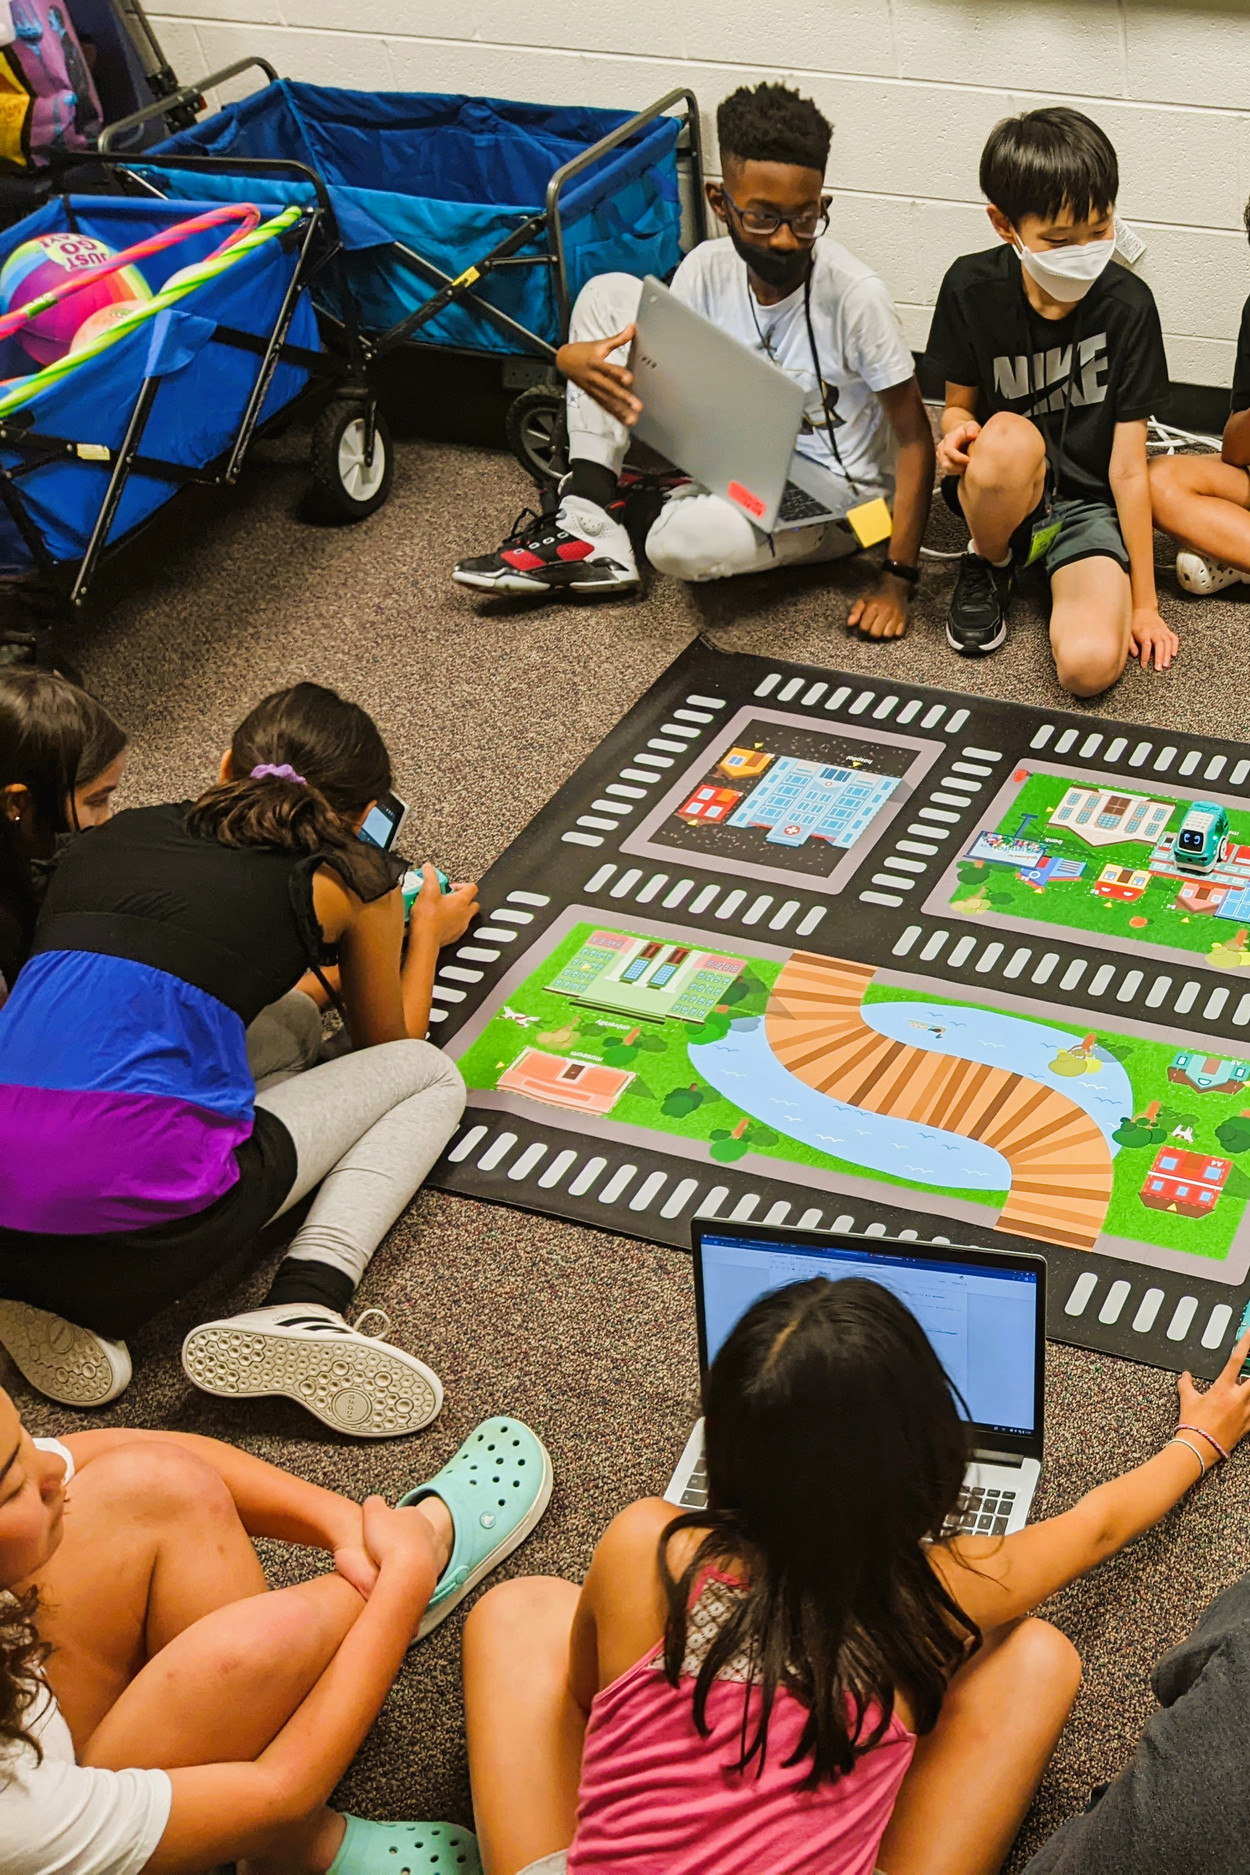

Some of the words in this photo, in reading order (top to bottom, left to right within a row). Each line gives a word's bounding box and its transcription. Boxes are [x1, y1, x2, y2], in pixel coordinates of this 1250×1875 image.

[60, 240, 97, 255] GO
[993, 332, 1109, 412] NIKE
[846, 755, 873, 765] hospital
[1045, 836, 1063, 845] bank
[596, 1019, 630, 1030] university
[571, 1051, 603, 1061] museum
[1211, 1160, 1224, 1168] A4
